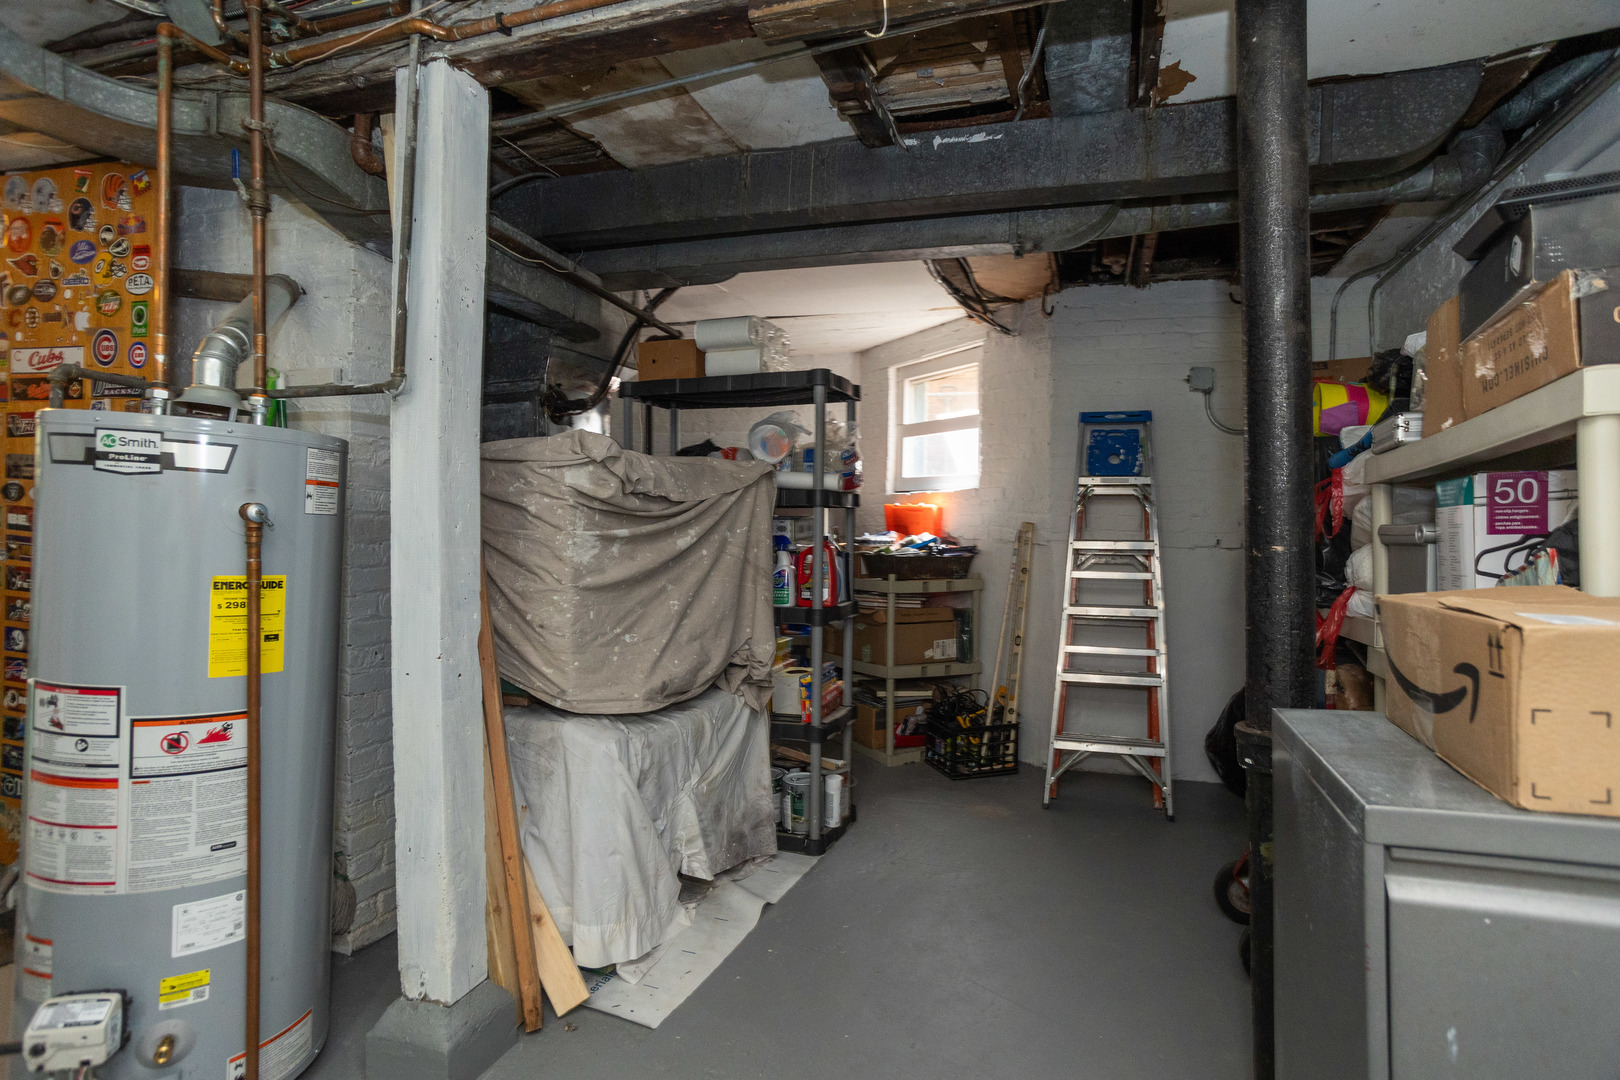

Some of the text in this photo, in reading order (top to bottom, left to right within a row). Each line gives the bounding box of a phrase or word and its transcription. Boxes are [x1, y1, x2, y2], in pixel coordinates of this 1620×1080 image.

[28, 348, 64, 367] Cubs
[1494, 477, 1539, 504] 50
[225, 601, 247, 609] 298
